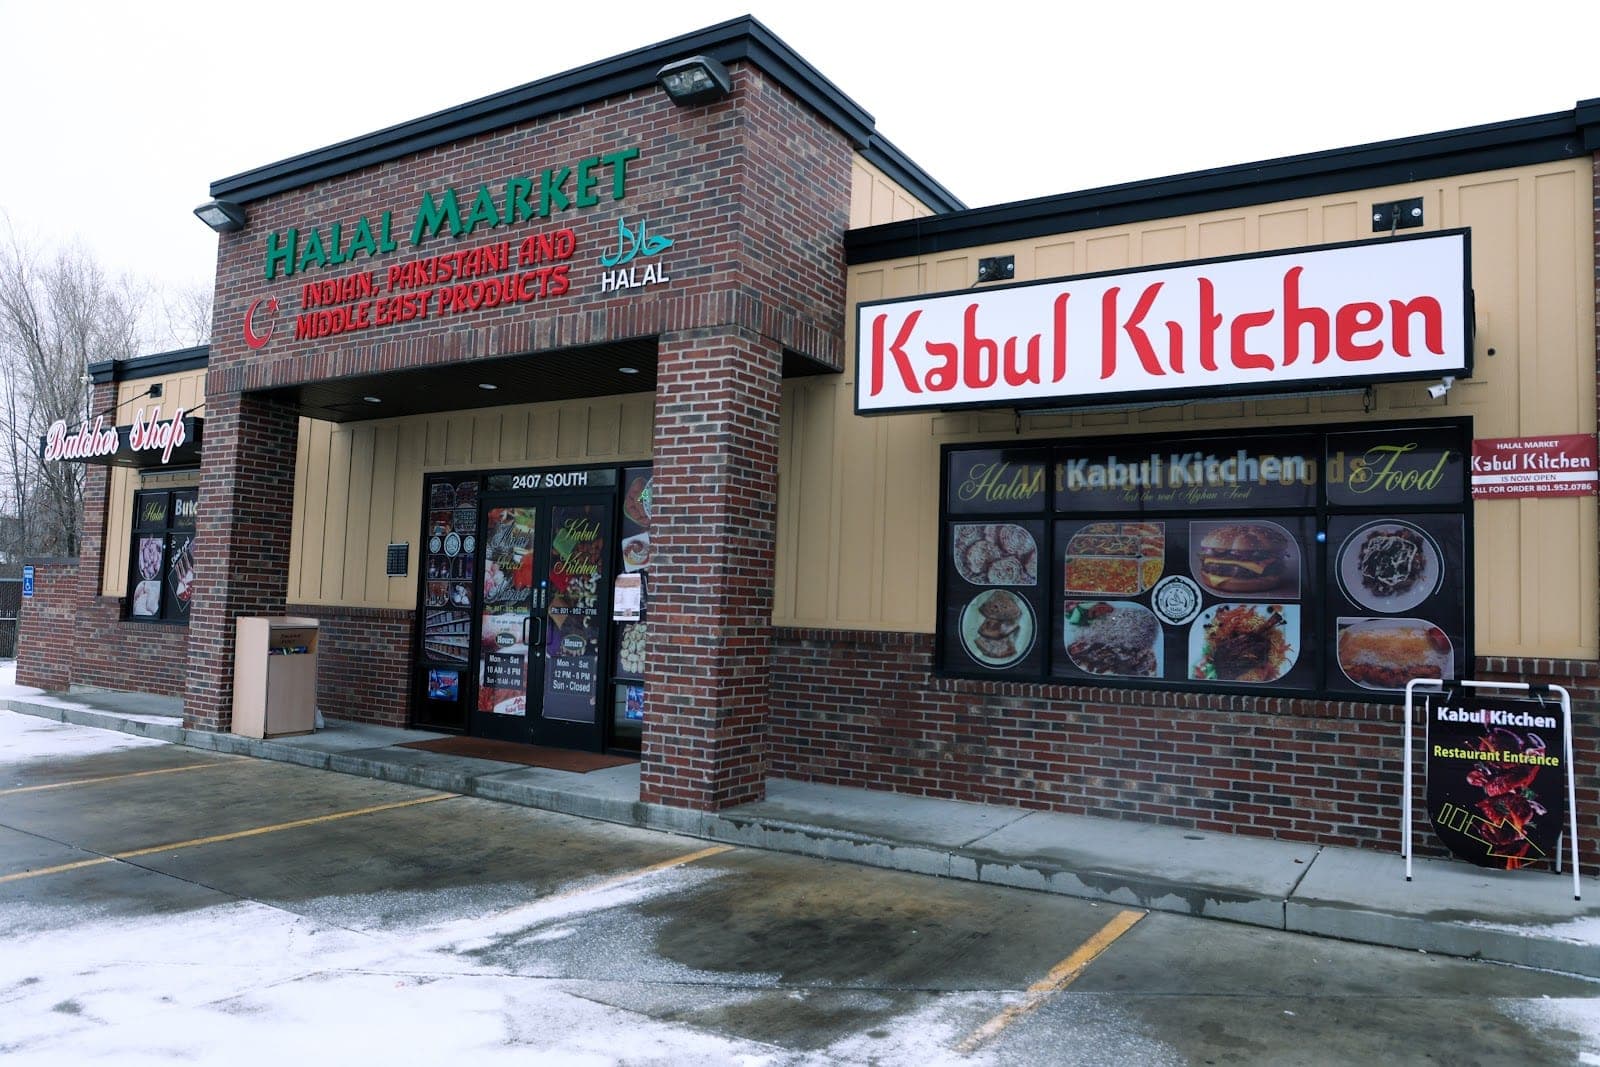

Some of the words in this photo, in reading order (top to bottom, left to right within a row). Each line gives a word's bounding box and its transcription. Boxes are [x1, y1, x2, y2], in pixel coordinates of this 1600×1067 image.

[265, 210, 397, 280] HALAL
[409, 147, 640, 246] MARKET
[600, 215, 674, 268] حلال
[301, 272, 380, 310] INDIAN,
[386, 241, 510, 293] PAKISTANI
[517, 228, 577, 267] AND
[601, 262, 670, 293] HALAL
[294, 301, 372, 341] MIDDLE
[375, 289, 433, 326] EAST
[437, 264, 571, 316] PRODUCTS
[869, 292, 1071, 397] Kabul
[1099, 265, 1446, 381] Kitchen
[45, 413, 120, 461] Butcher
[129, 405, 186, 464] Shop
[1496, 442, 1523, 450] HALAL
[1524, 440, 1560, 449] MARKET
[1066, 453, 1161, 489] Kabul
[1170, 449, 1305, 486] Kitchen
[1349, 442, 1450, 494] Food
[1471, 453, 1517, 472] Kabul
[1523, 451, 1591, 470] Kitchen
[512, 474, 541, 489] 2407
[545, 471, 588, 488] SOUTH
[958, 461, 1042, 502] Halal
[1506, 485, 1535, 493] ORDER
[564, 518, 600, 541] Kabul
[553, 551, 598, 575] Kitchen
[556, 658, 570, 667] Mon
[552, 679, 565, 691] Sun
[570, 680, 591, 692] Closed
[1437, 706, 1486, 724] Kabul
[1490, 710, 1557, 729] Kitchen
[1433, 745, 1500, 762] Restaurant
[1503, 750, 1560, 767] Entrance
